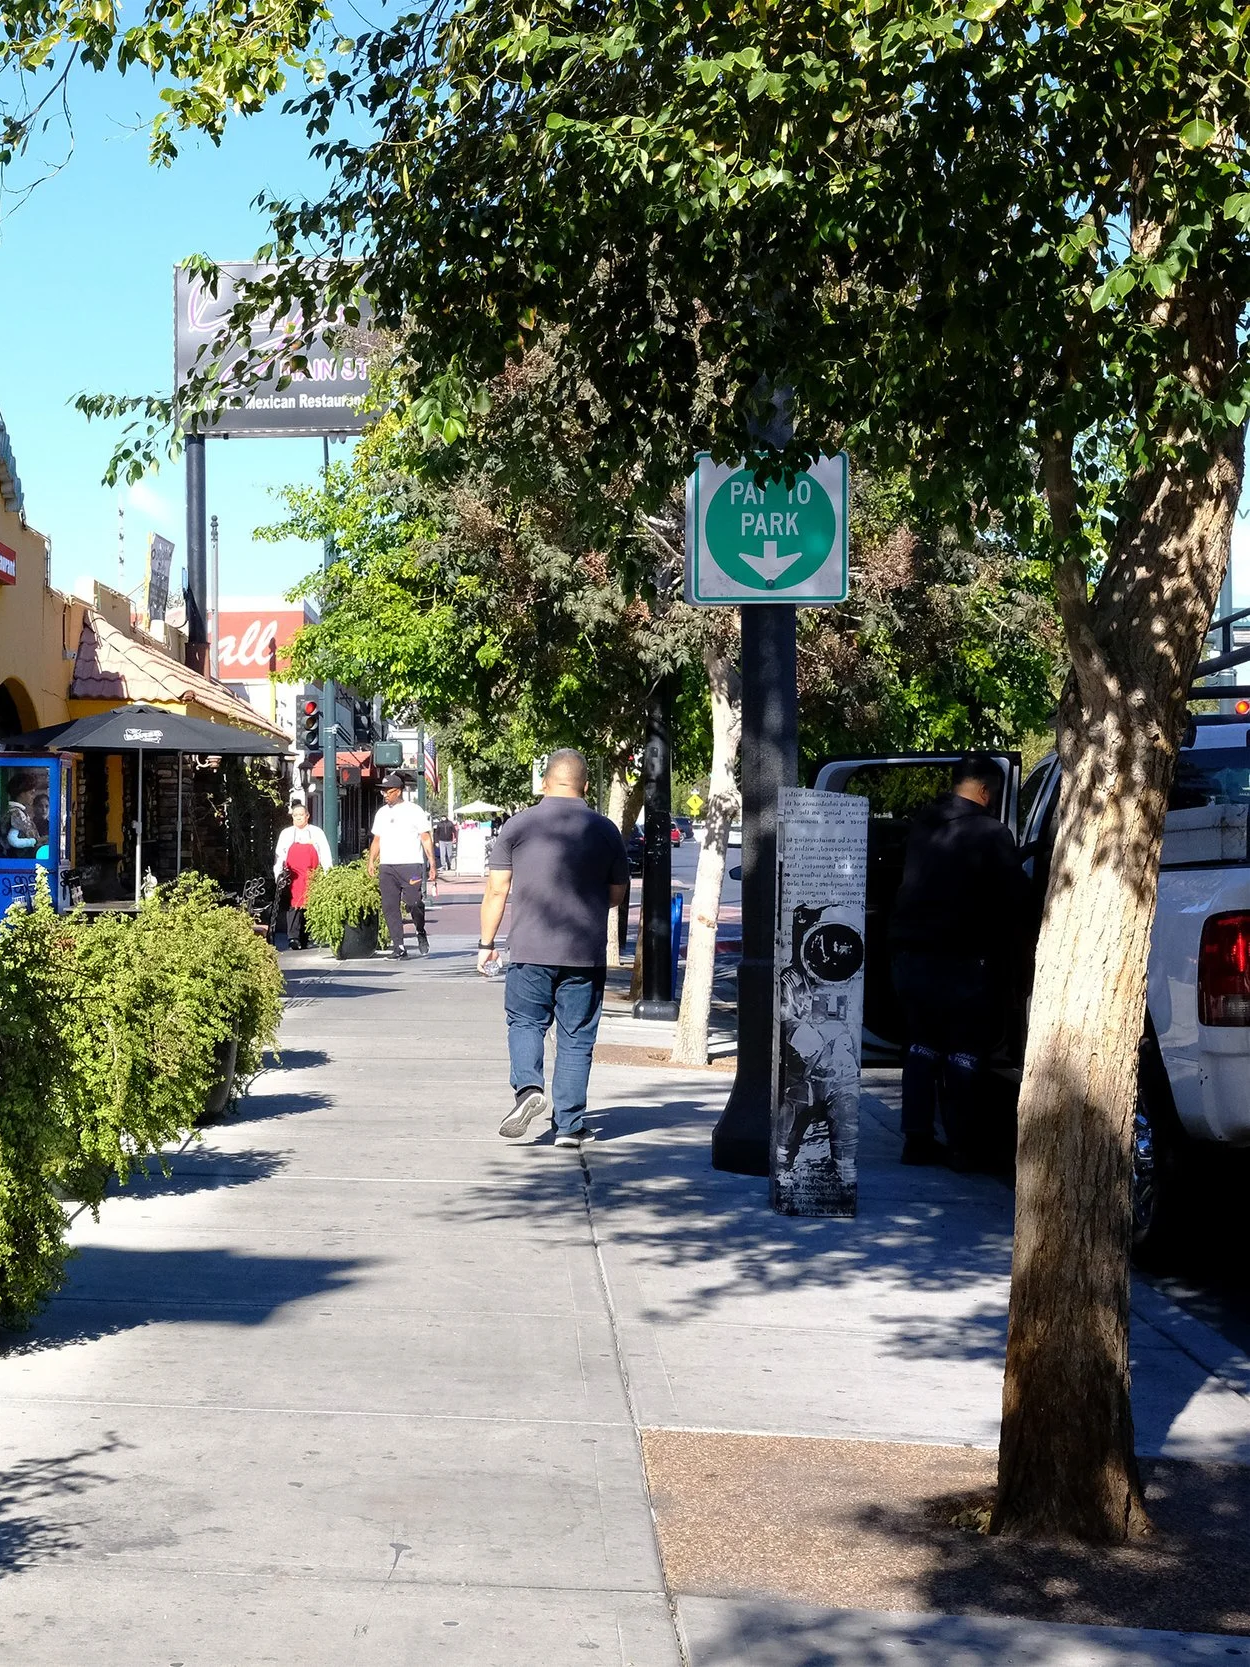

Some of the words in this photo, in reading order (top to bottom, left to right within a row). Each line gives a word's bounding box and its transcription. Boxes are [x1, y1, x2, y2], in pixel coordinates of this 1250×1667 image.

[245, 394, 295, 410] Mexican
[730, 481, 769, 505] PAY
[741, 512, 800, 536] PARK
[216, 620, 278, 666] all
